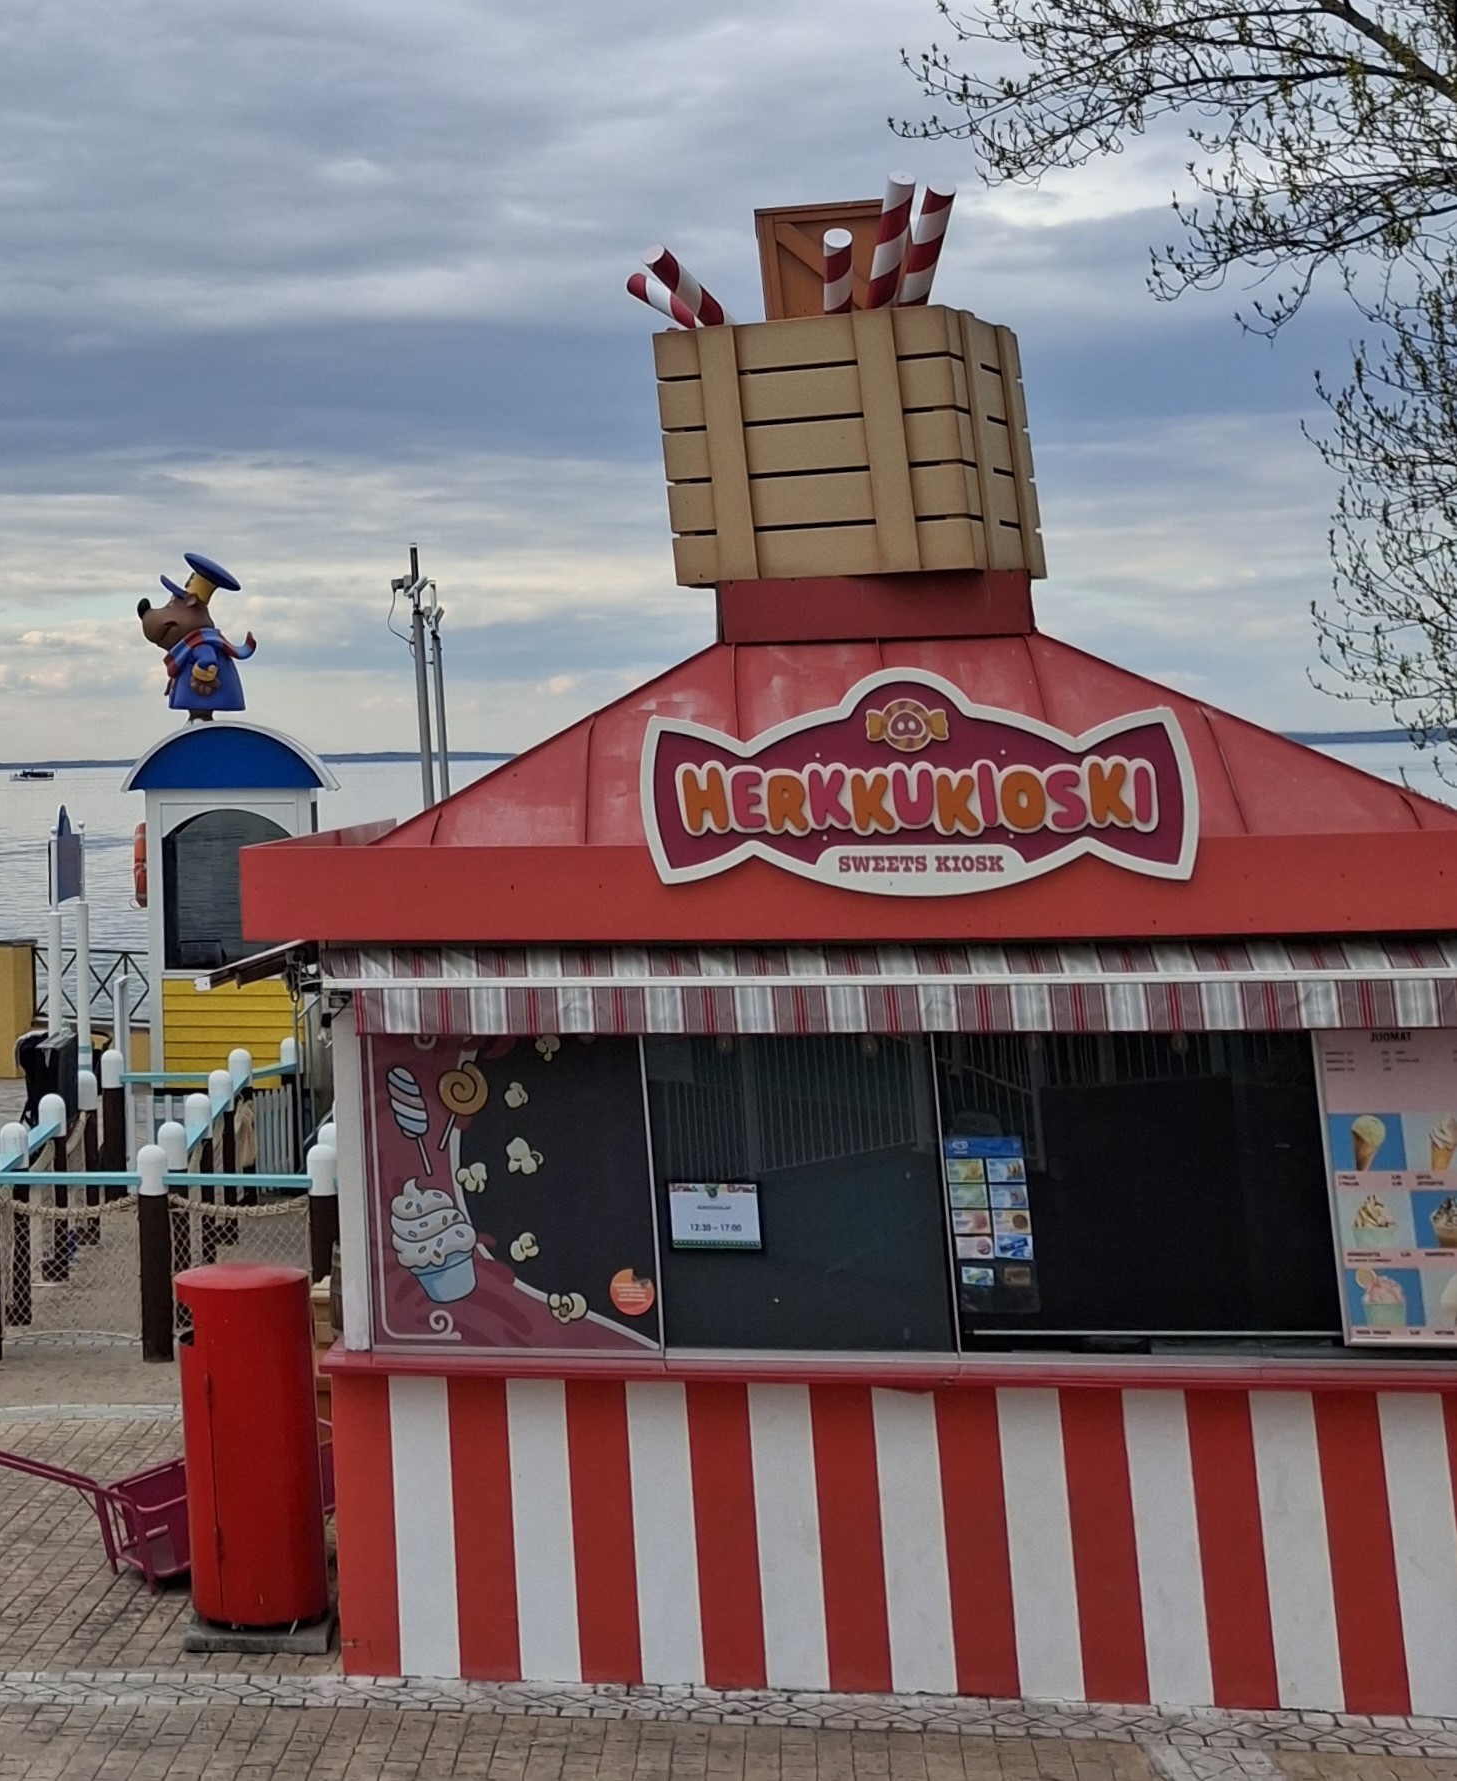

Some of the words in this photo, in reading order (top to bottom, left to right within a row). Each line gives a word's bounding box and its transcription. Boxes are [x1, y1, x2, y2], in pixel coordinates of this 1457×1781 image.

[677, 756, 1158, 836] HERKKUKIOSKI
[838, 855, 928, 874] SWEETS
[935, 854, 1005, 873] KIOSK
[1370, 1031, 1412, 1042] JUOMAT
